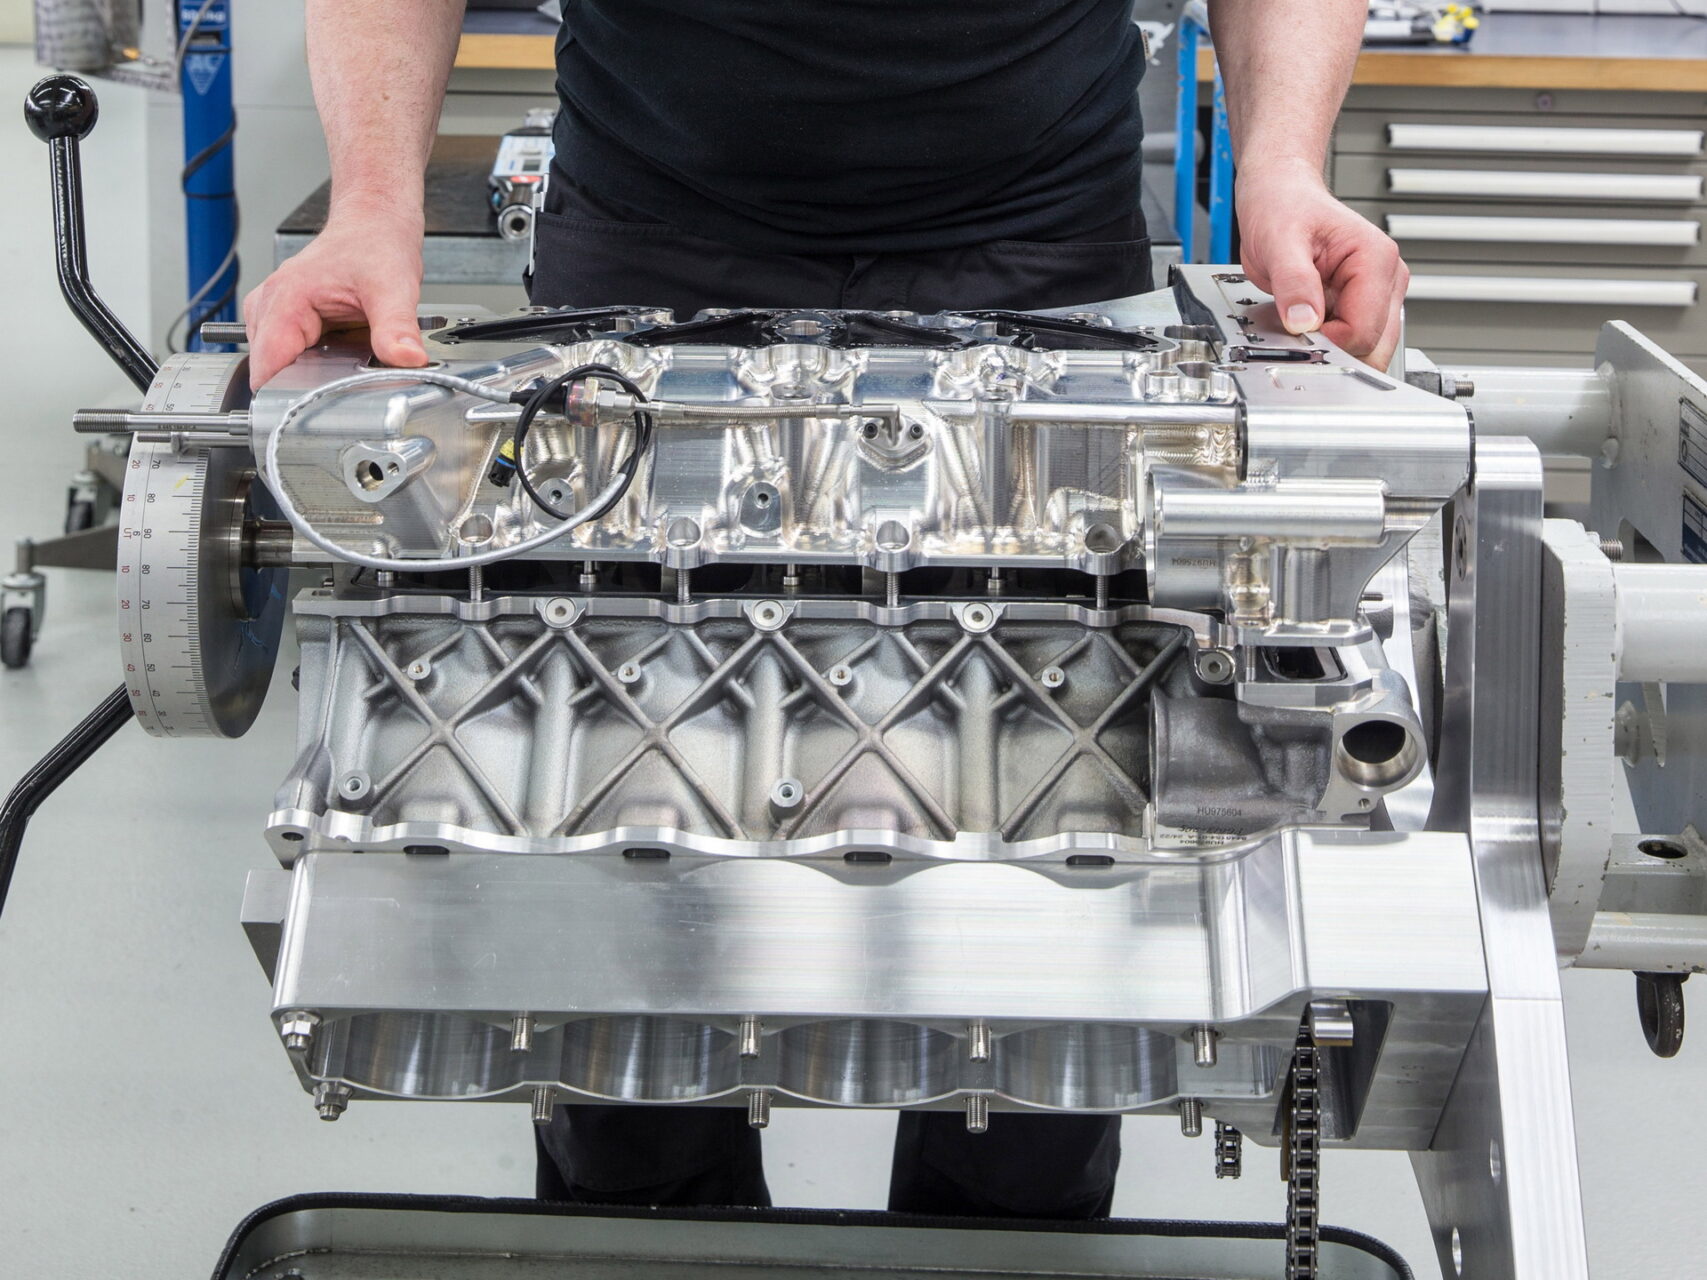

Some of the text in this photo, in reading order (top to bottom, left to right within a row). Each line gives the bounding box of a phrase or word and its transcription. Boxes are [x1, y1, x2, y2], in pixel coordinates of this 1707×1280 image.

[166, 403, 174, 412] 50
[132, 459, 140, 469] 20
[152, 459, 161, 469] 70
[126, 494, 136, 502] 10
[146, 493, 156, 503] 80
[123, 527, 132, 540] UT
[144, 528, 152, 539] 90
[122, 564, 130, 574] 10
[142, 564, 150, 574] 80
[121, 600, 130, 610] 20
[142, 600, 150, 610] 70
[122, 632, 132, 642] 30
[144, 633, 152, 643] 60
[126, 664, 136, 672] 40
[146, 664, 156, 672] 50
